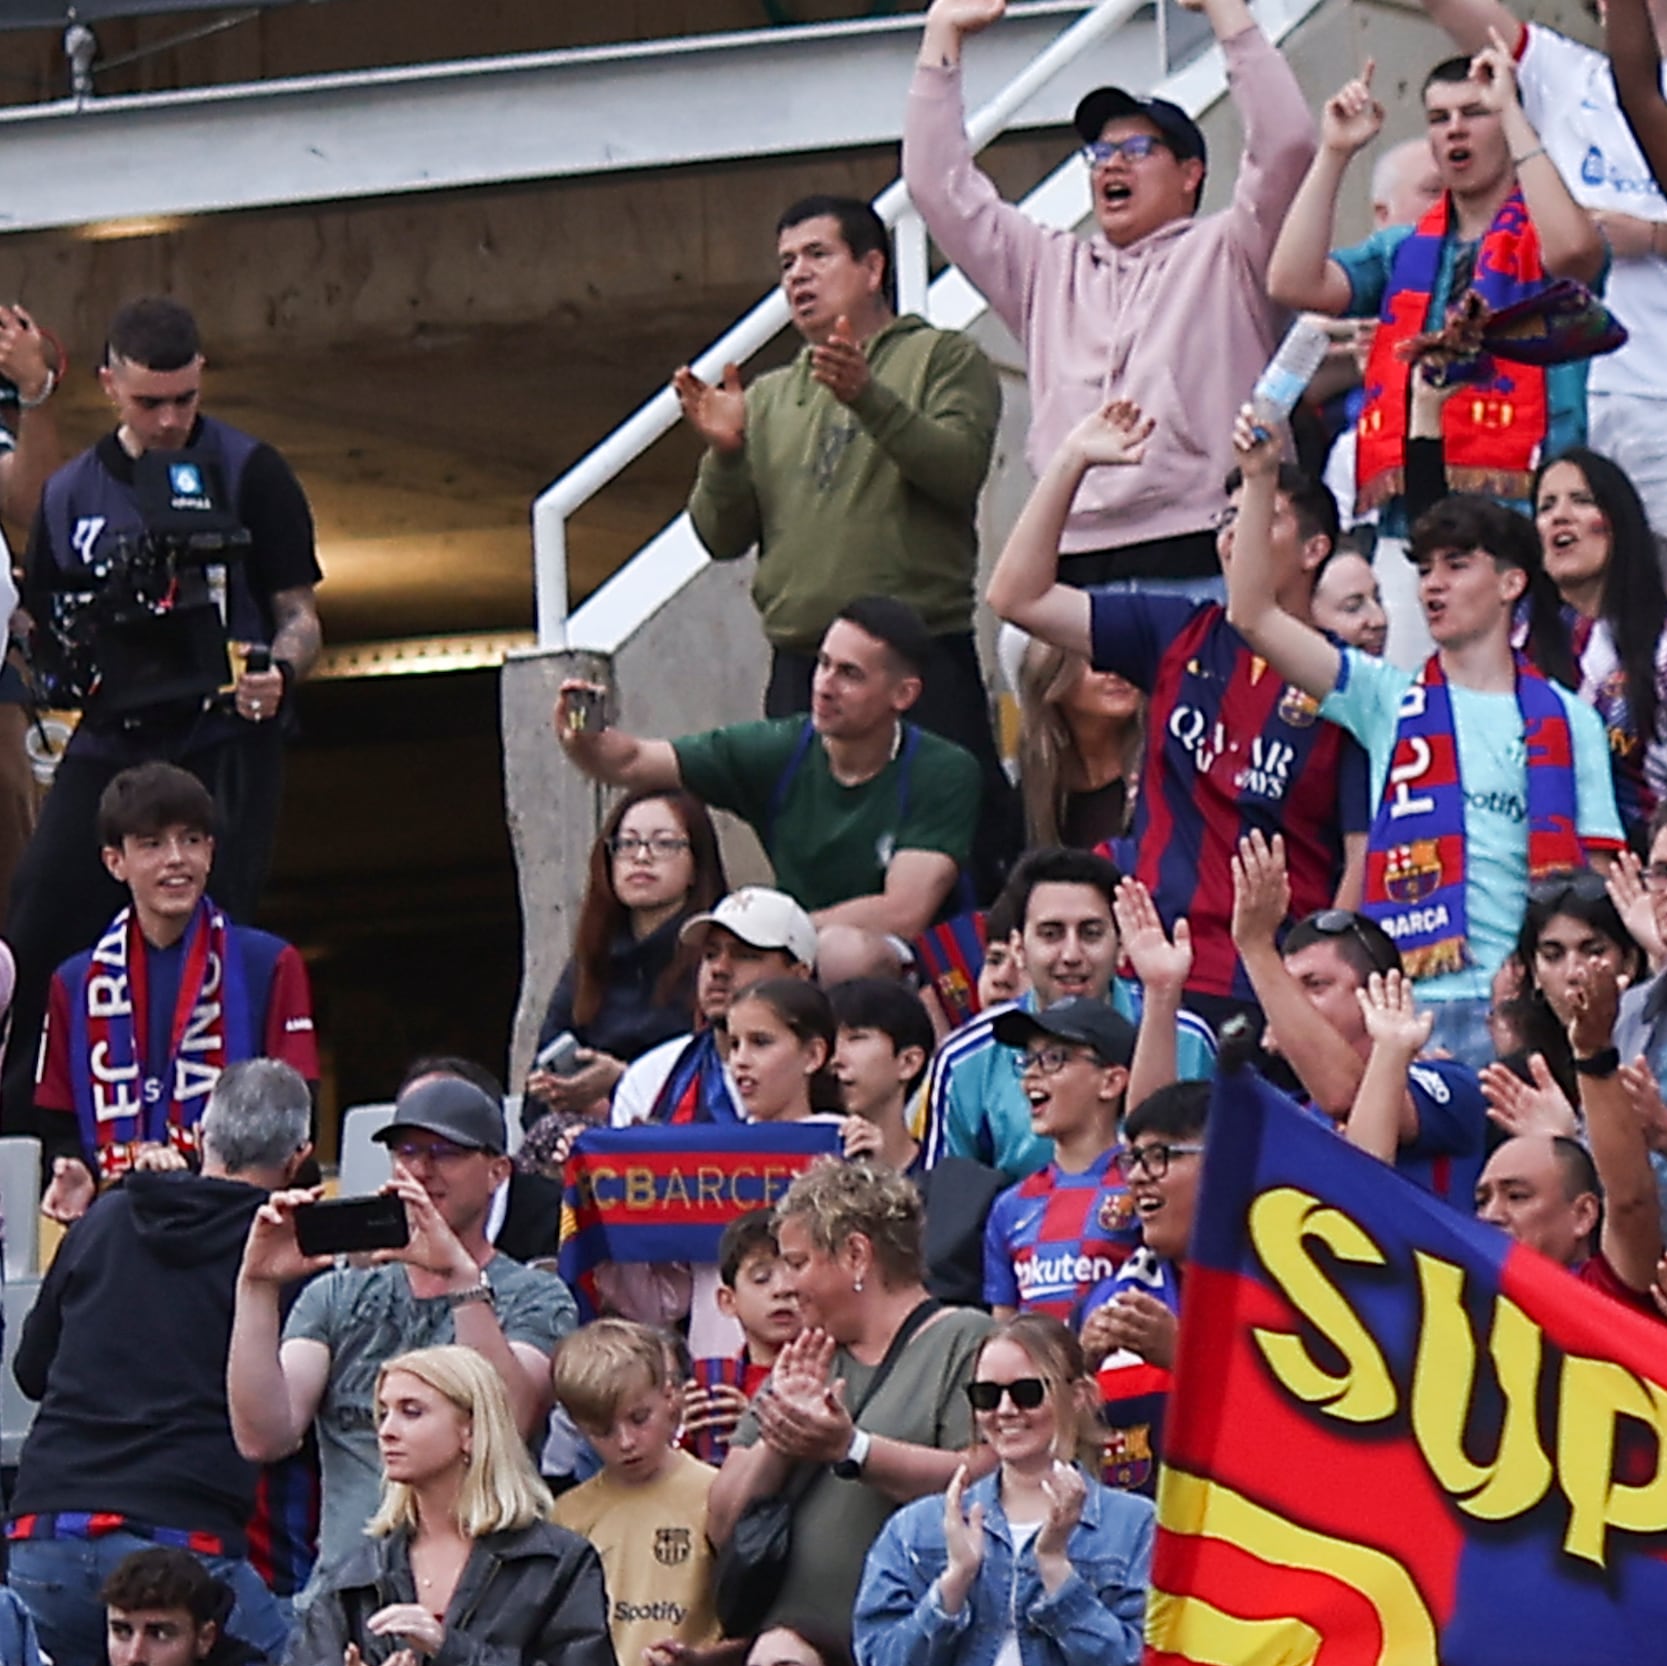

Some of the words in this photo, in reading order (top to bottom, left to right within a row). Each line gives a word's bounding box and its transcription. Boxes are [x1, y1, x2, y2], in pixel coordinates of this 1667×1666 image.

[1462, 786, 1529, 826] otify
[1380, 903, 1450, 940] BARÇA
[173, 948, 226, 1103] ONA
[1014, 1254, 1114, 1287] akuten
[613, 1601, 688, 1626] Spotify
